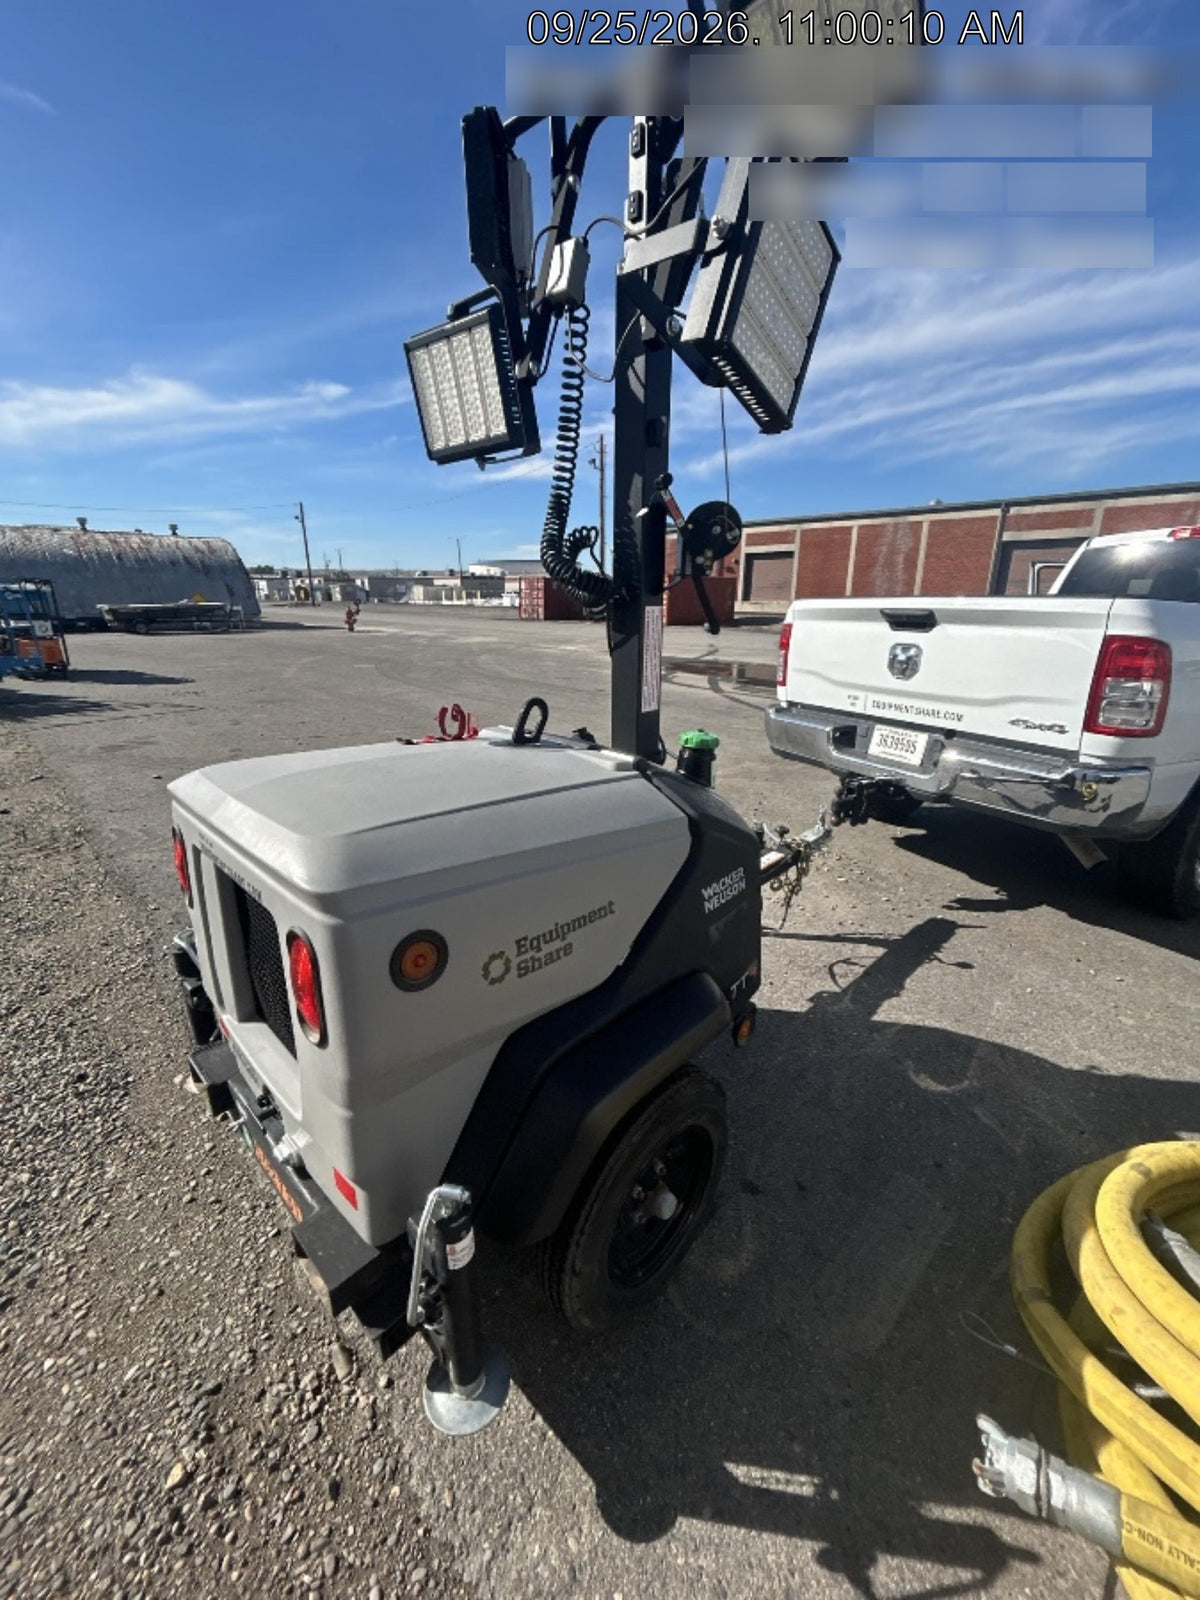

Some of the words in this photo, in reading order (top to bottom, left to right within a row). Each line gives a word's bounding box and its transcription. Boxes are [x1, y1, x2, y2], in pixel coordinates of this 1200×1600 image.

[702, 867, 744, 900] WACKER
[704, 879, 746, 914] NEUSON
[515, 900, 616, 957] Equipment
[516, 942, 573, 978] Share
